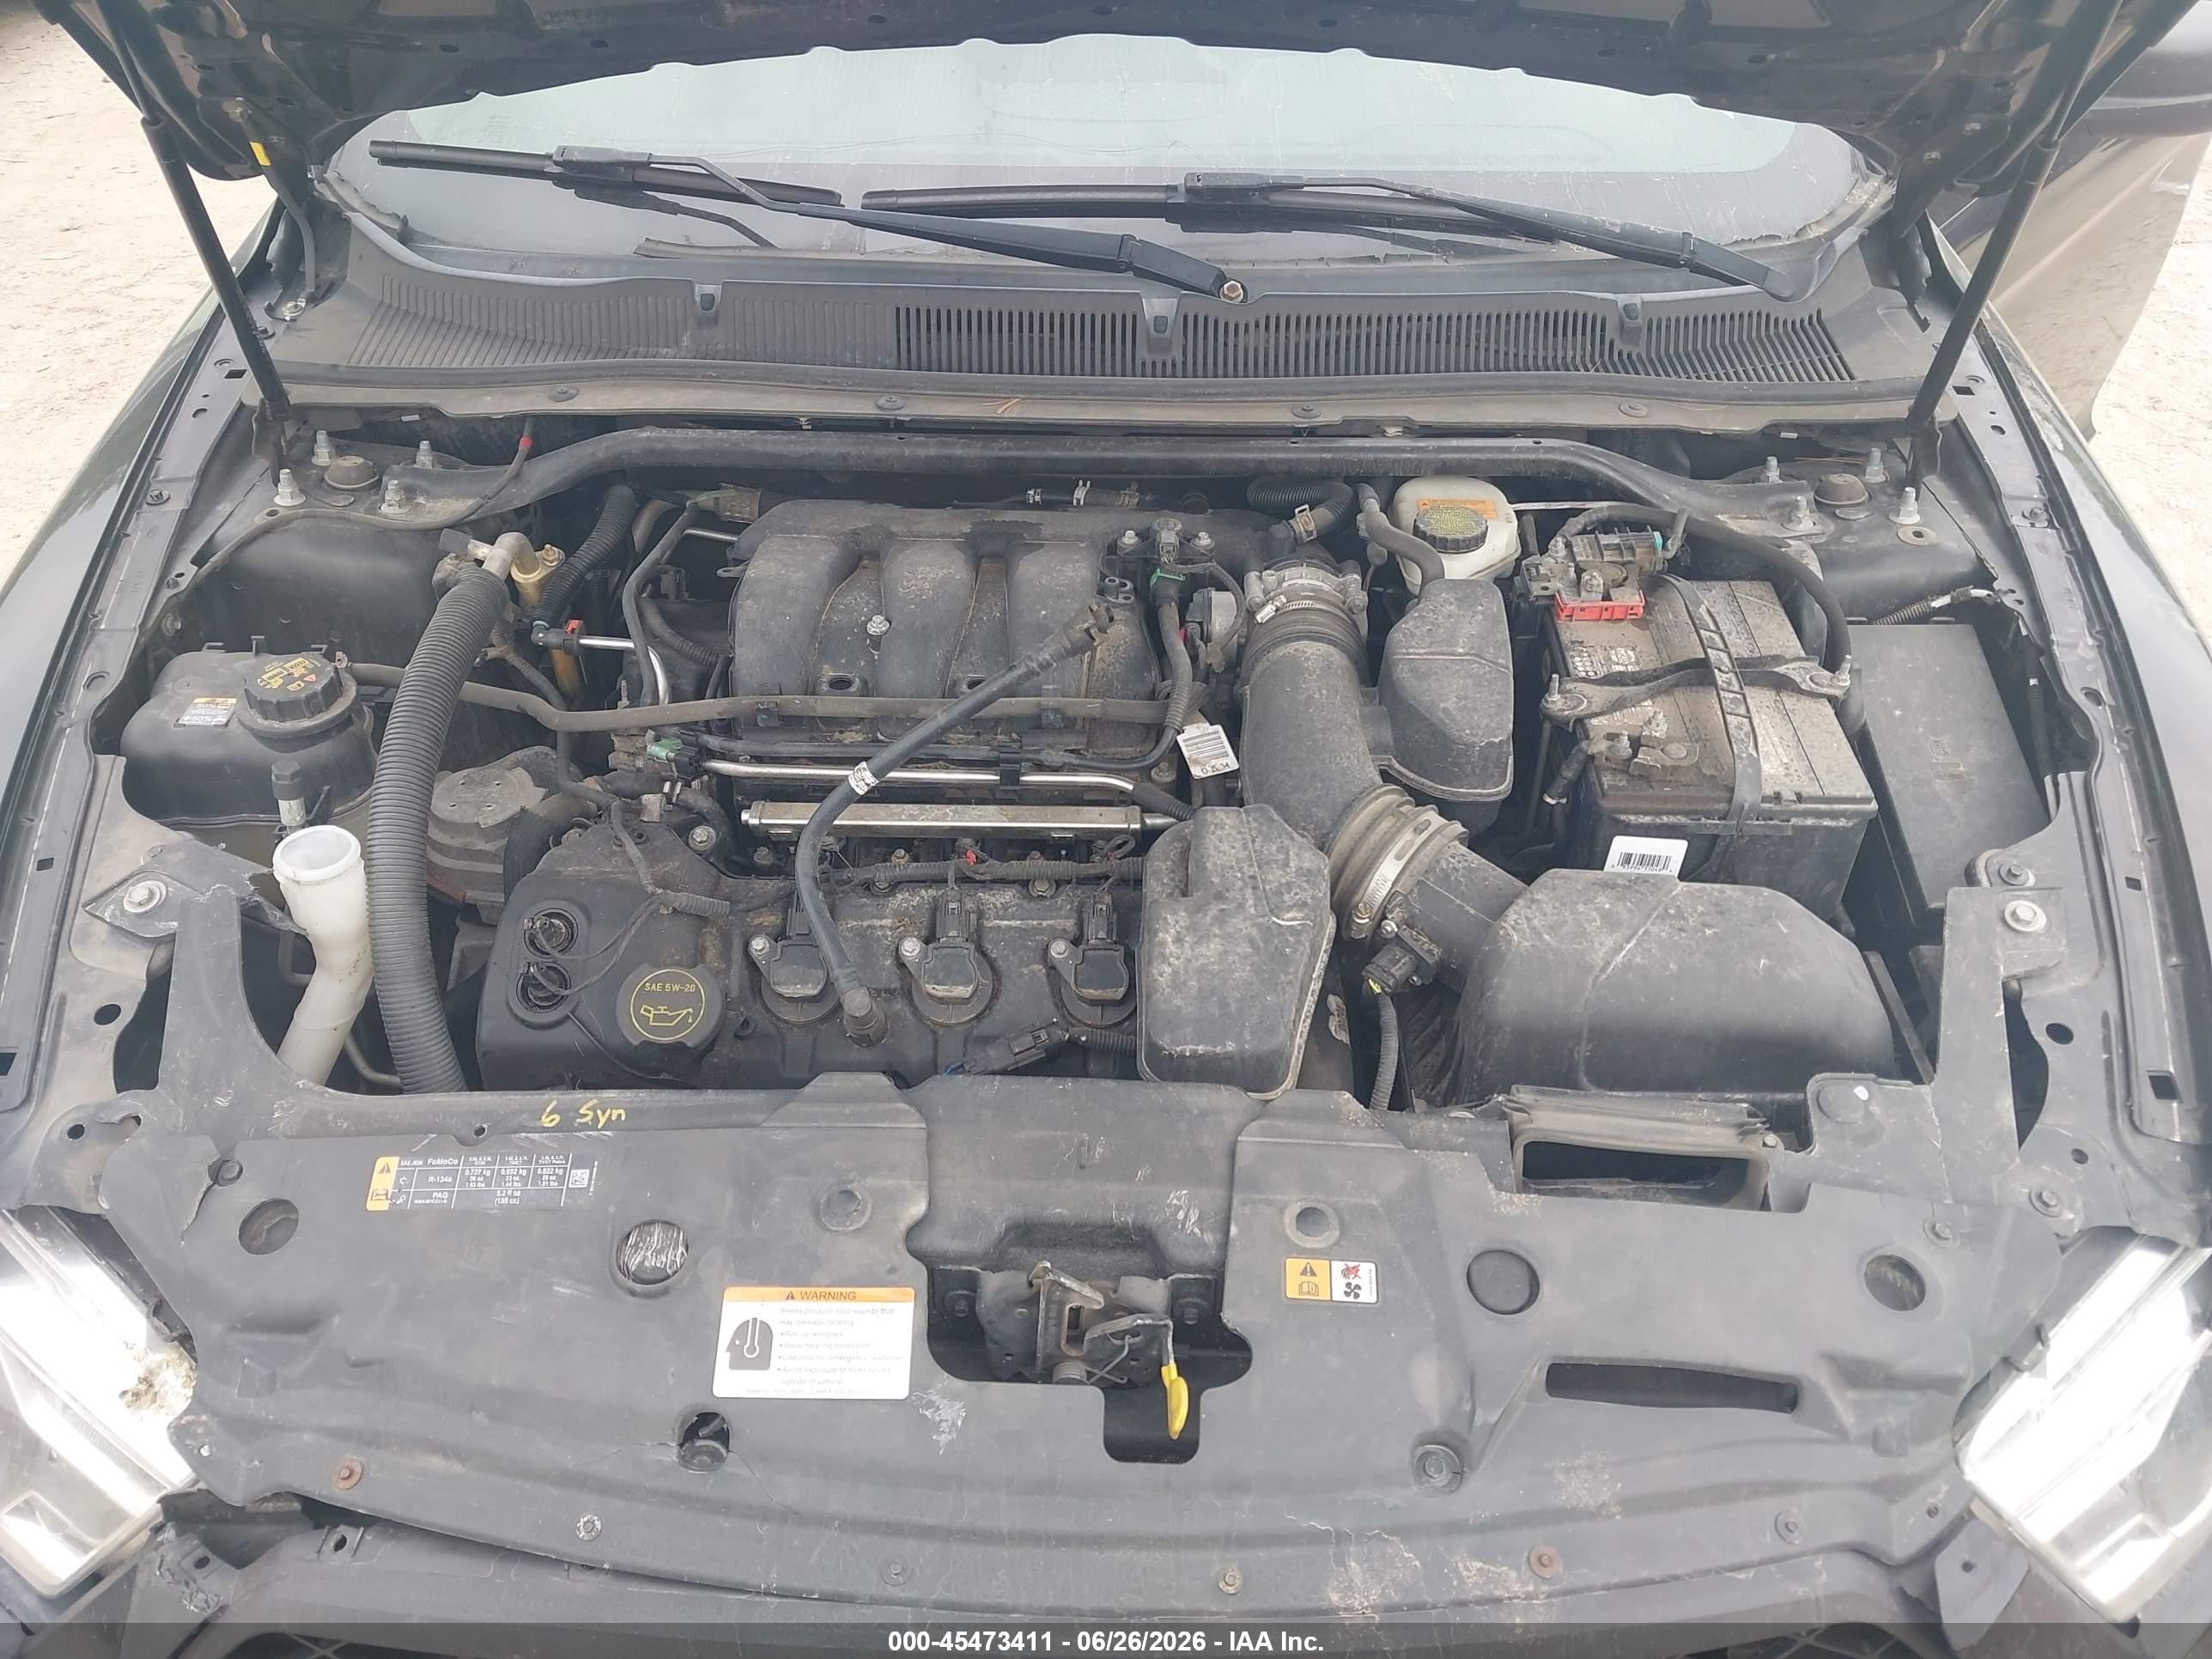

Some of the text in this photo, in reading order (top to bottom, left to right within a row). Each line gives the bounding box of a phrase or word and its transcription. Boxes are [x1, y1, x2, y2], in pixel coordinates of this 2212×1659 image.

[644, 982, 696, 993] SAE 5W-20
[541, 1099, 626, 1129] 6 Syn
[427, 1158, 459, 1166] FoMoCo
[483, 1169, 491, 1177] kg
[518, 1168, 527, 1177] kg
[799, 1291, 857, 1301] WARNING
